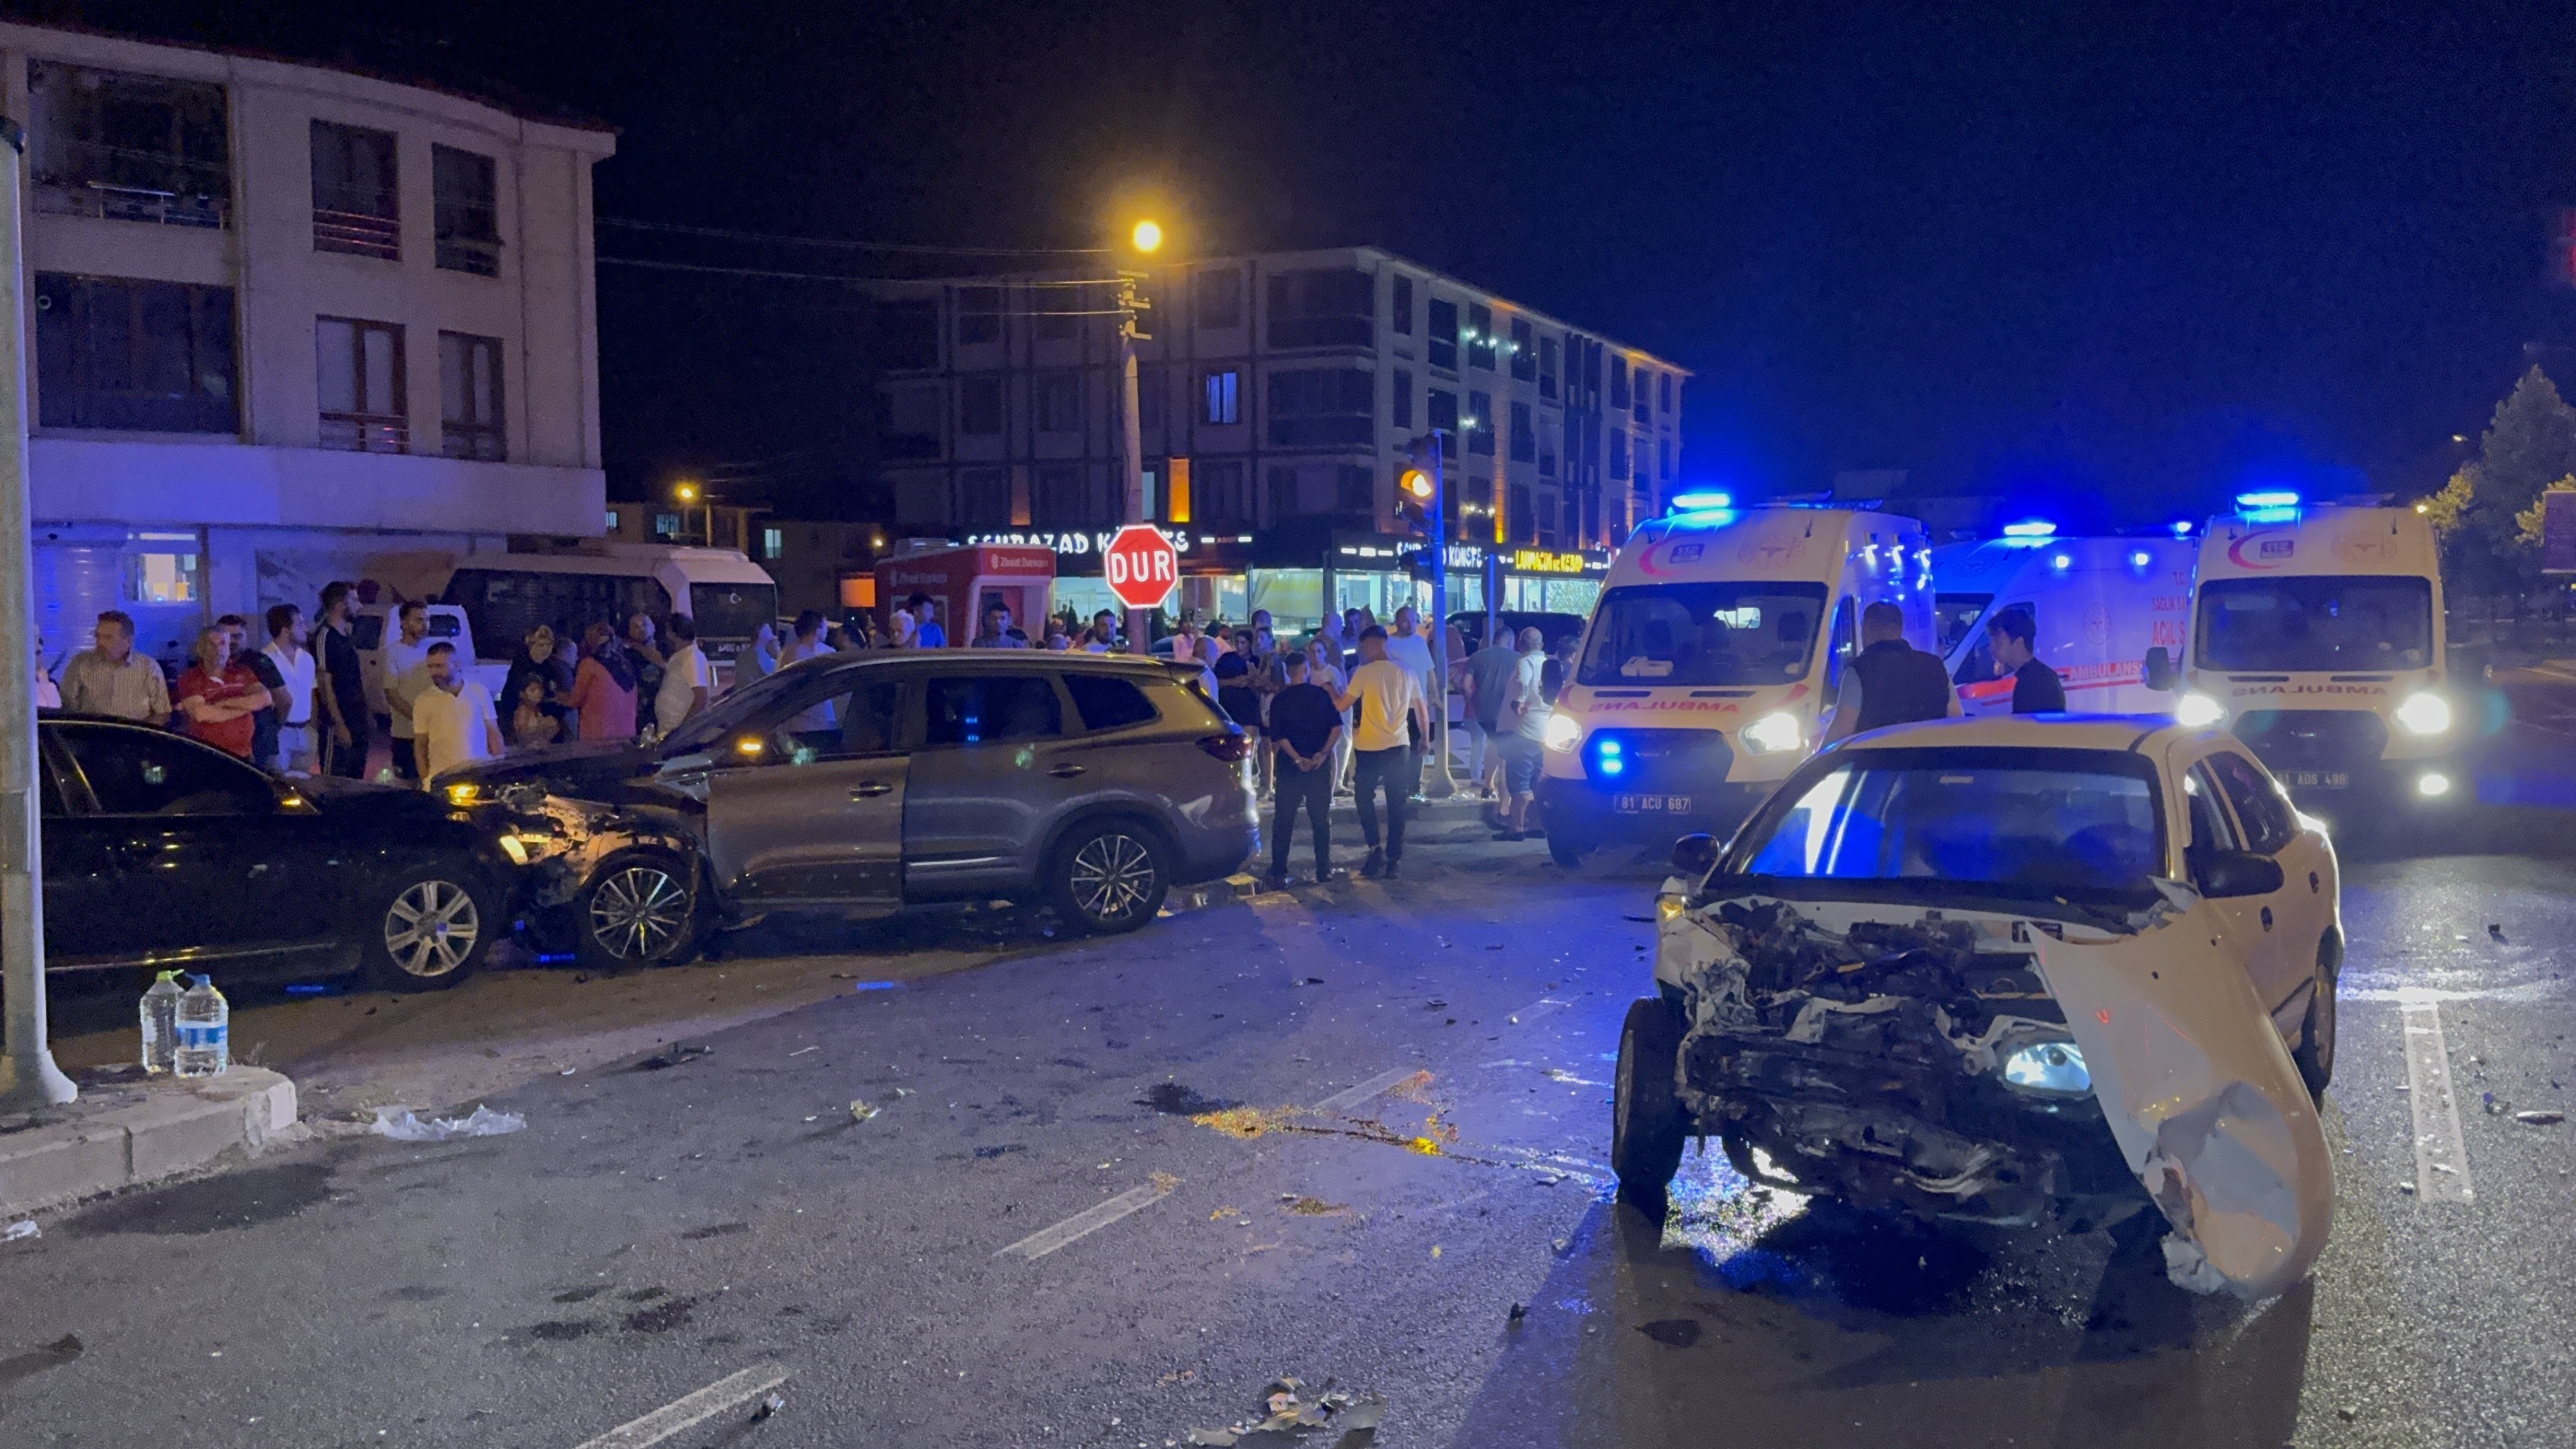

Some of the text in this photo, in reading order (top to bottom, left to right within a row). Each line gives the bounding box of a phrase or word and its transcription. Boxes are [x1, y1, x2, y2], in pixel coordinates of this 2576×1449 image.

[1000, 556, 1021, 567] Ziraat
[1110, 550, 1171, 584] DUR
[2069, 662, 2140, 681] AMBULANS
[1622, 796, 1688, 810] 81 ACU 687
